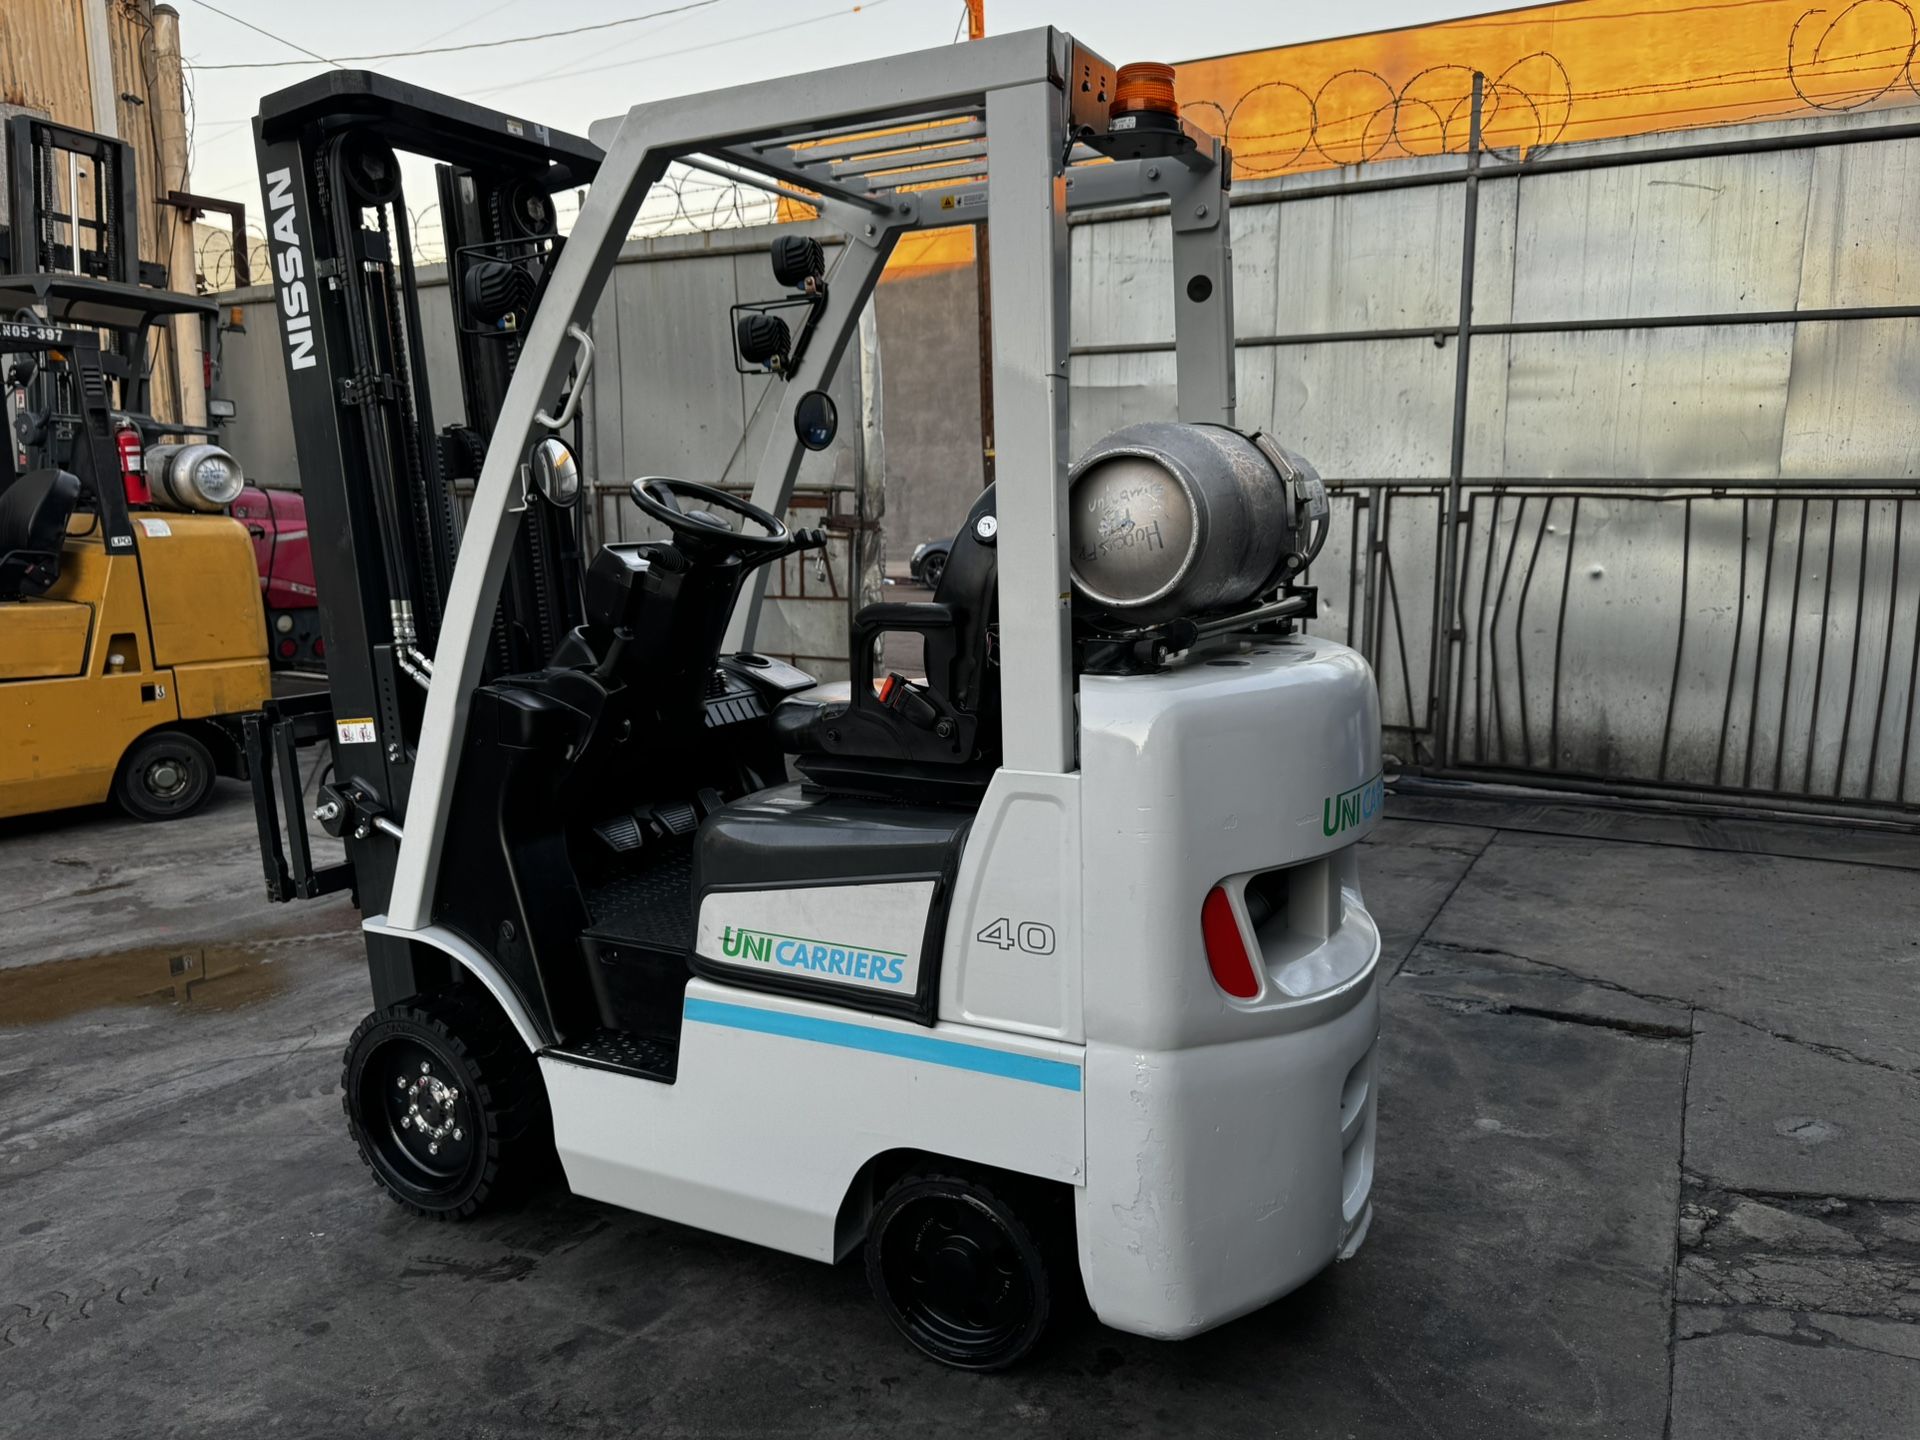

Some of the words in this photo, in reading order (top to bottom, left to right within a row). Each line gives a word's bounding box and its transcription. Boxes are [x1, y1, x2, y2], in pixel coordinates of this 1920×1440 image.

[266, 167, 316, 370] NISSAN
[0, 324, 63, 341] N05-397
[977, 917, 1055, 955] 40
